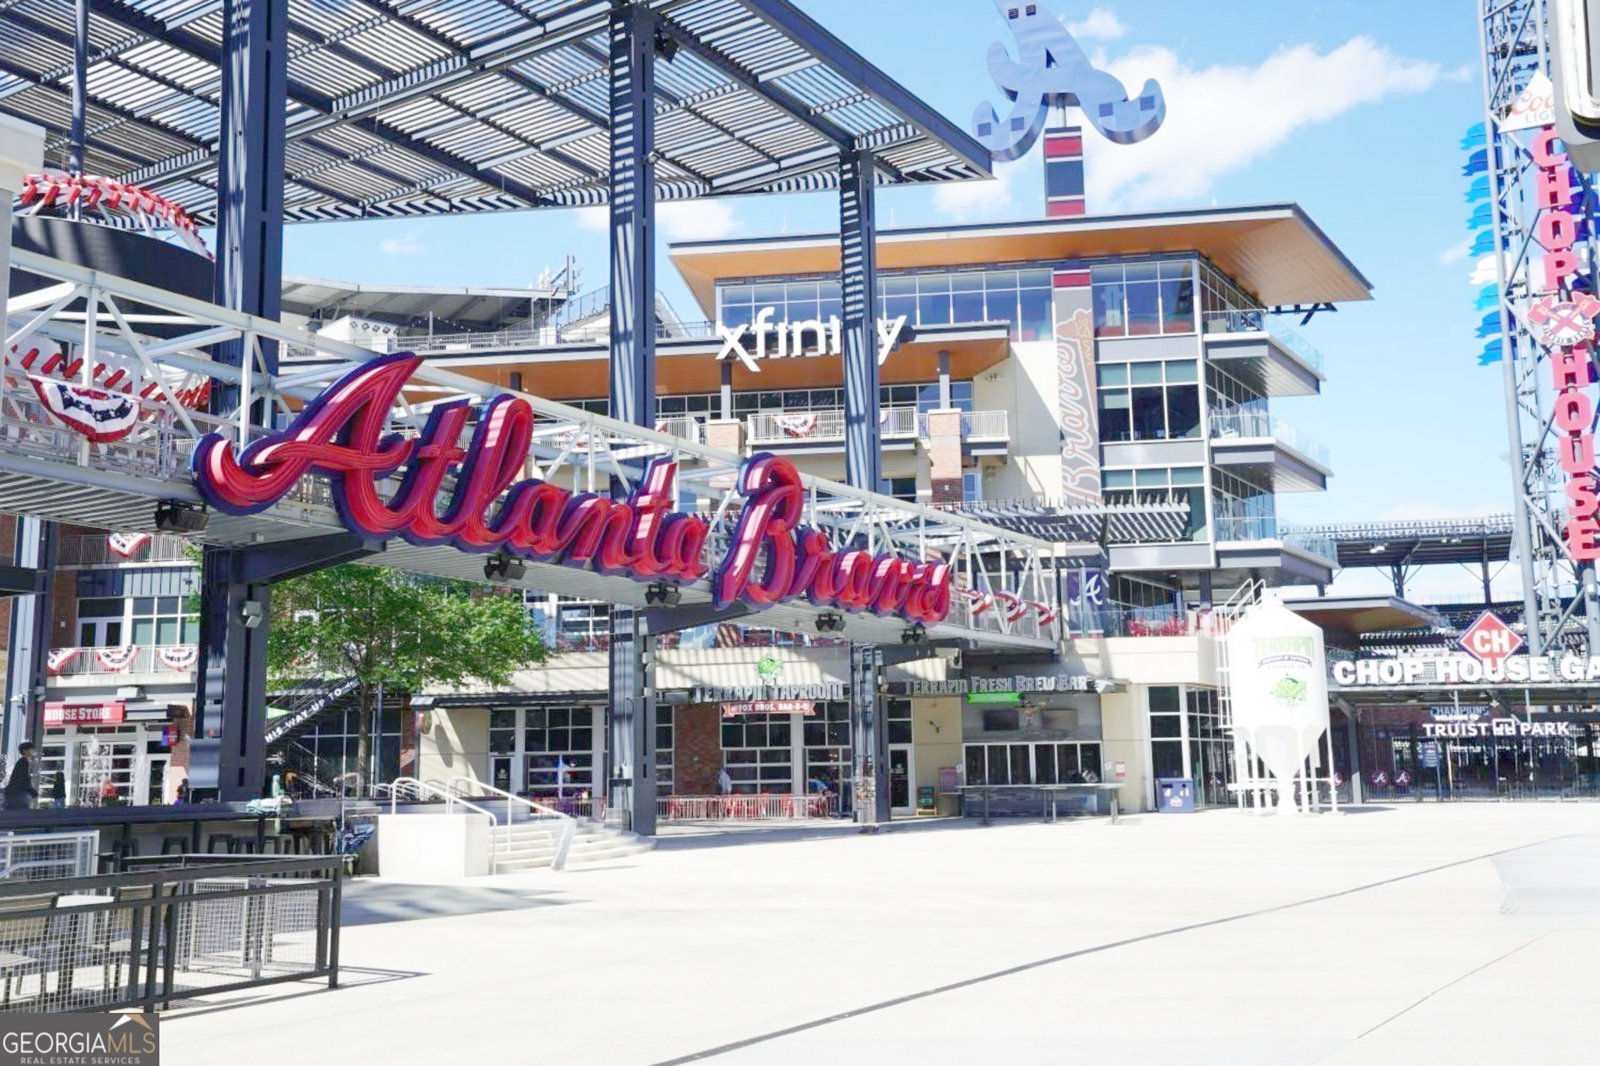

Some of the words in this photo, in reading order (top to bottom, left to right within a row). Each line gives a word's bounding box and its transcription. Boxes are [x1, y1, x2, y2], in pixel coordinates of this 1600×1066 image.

[1525, 109, 1555, 124] LIG
[1532, 130, 1578, 291] CHOP
[716, 306, 907, 373] xfiniy
[1552, 350, 1600, 560] HOUSE
[191, 351, 709, 585] Atlanta
[713, 451, 952, 627] Braves
[1472, 630, 1511, 654] CH
[1333, 660, 1424, 684] CHOP
[1437, 656, 1549, 683] HOUSE
[693, 684, 768, 703] TERRAPIN
[772, 681, 844, 701] TAPROOM
[904, 678, 967, 696] TERRAPIN
[971, 675, 1012, 693] FRESH
[1015, 674, 1056, 691] BREW
[1058, 673, 1088, 691] BAR
[79, 708, 112, 719] STORE
[285, 709, 308, 729] WAY
[311, 699, 325, 712] UP
[328, 688, 342, 700] TO
[1423, 723, 1487, 737] TRUIST
[1520, 722, 1570, 736] PARK
